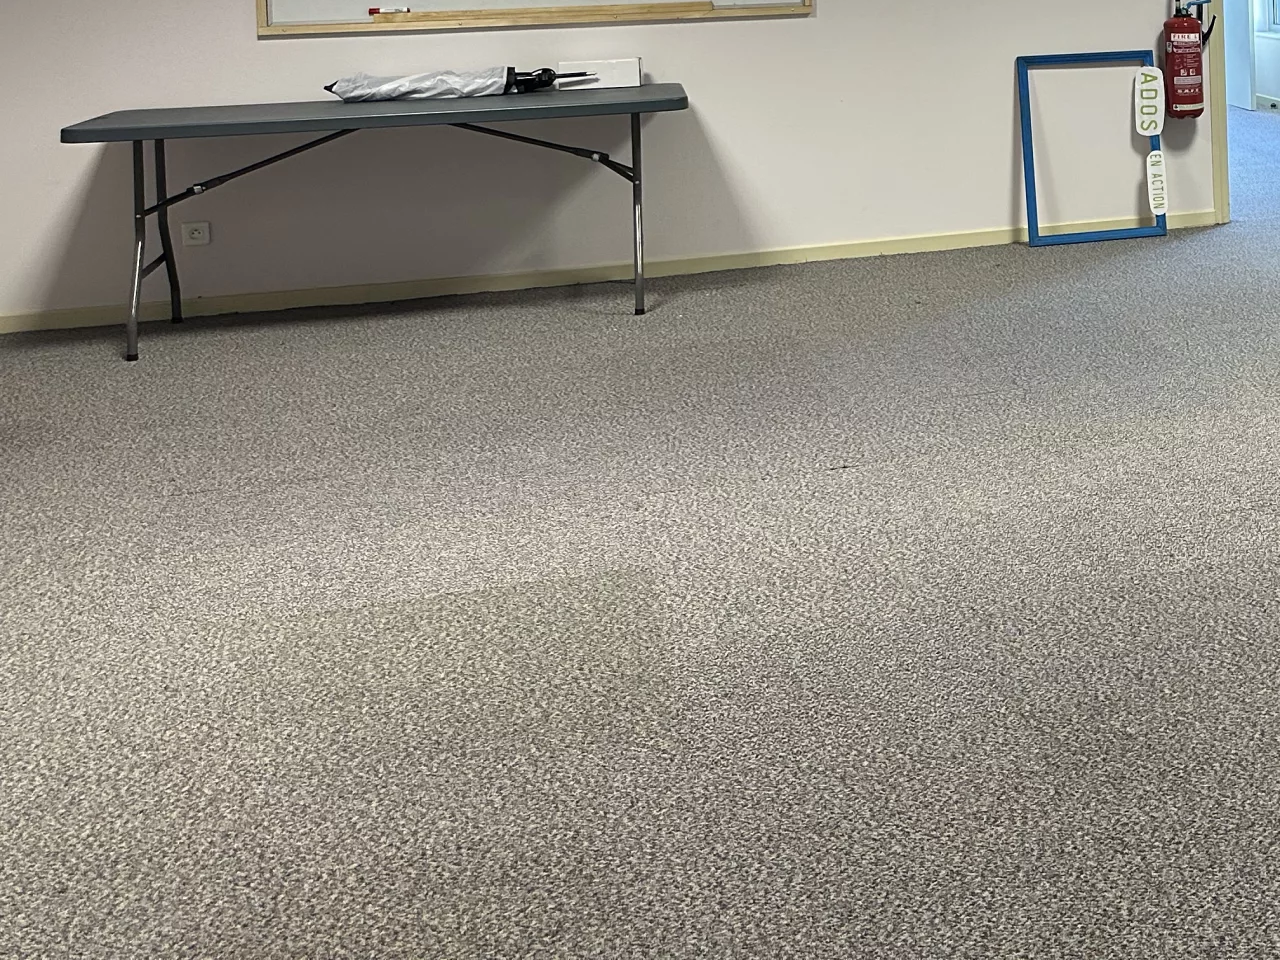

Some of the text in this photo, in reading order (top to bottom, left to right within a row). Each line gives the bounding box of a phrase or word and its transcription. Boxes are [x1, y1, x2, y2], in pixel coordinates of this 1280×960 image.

[1140, 72, 1158, 132] ADOS
[1149, 153, 1165, 209] EN ACTION
